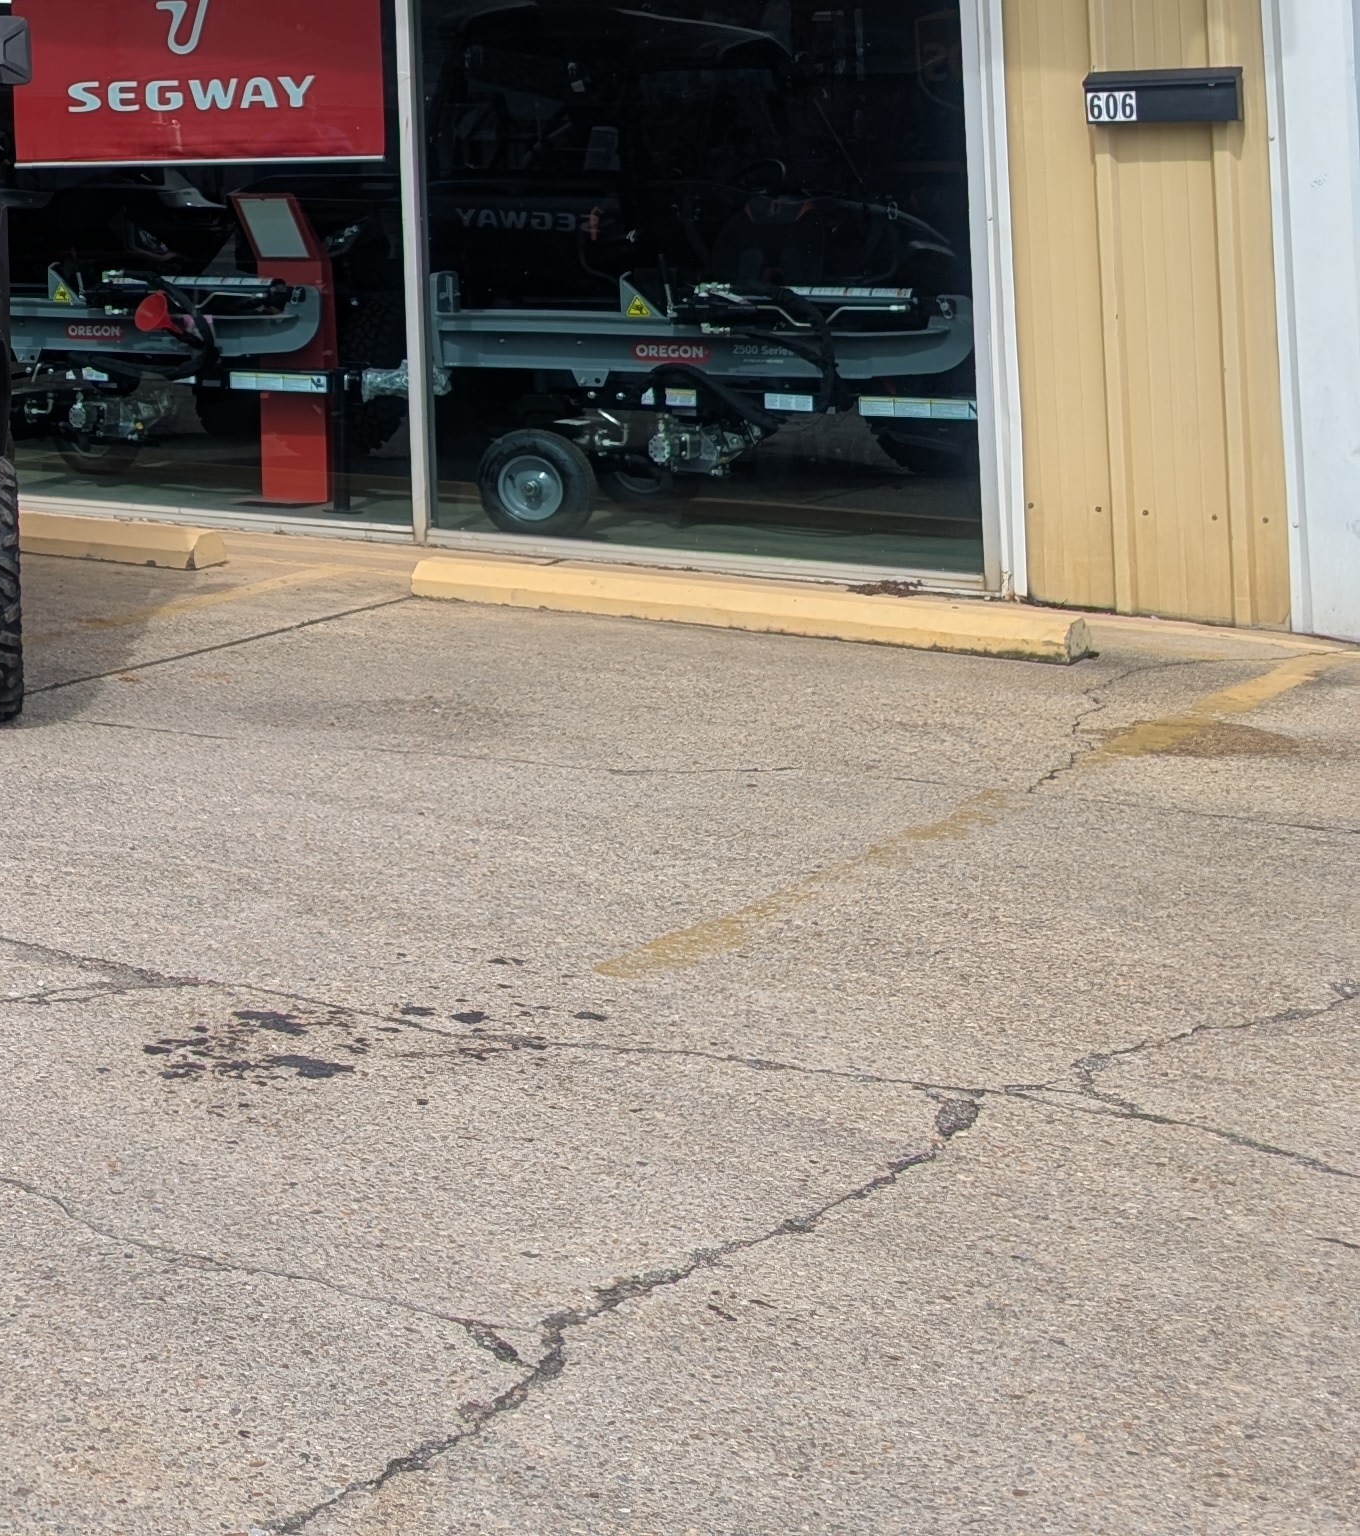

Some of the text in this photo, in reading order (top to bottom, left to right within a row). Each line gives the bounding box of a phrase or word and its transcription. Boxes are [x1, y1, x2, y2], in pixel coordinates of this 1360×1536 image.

[67, 75, 316, 114] SEGWAY
[1089, 93, 1135, 120] 606
[68, 325, 121, 337] OREGON
[635, 344, 704, 358] OREGON
[732, 344, 758, 355] 2500
